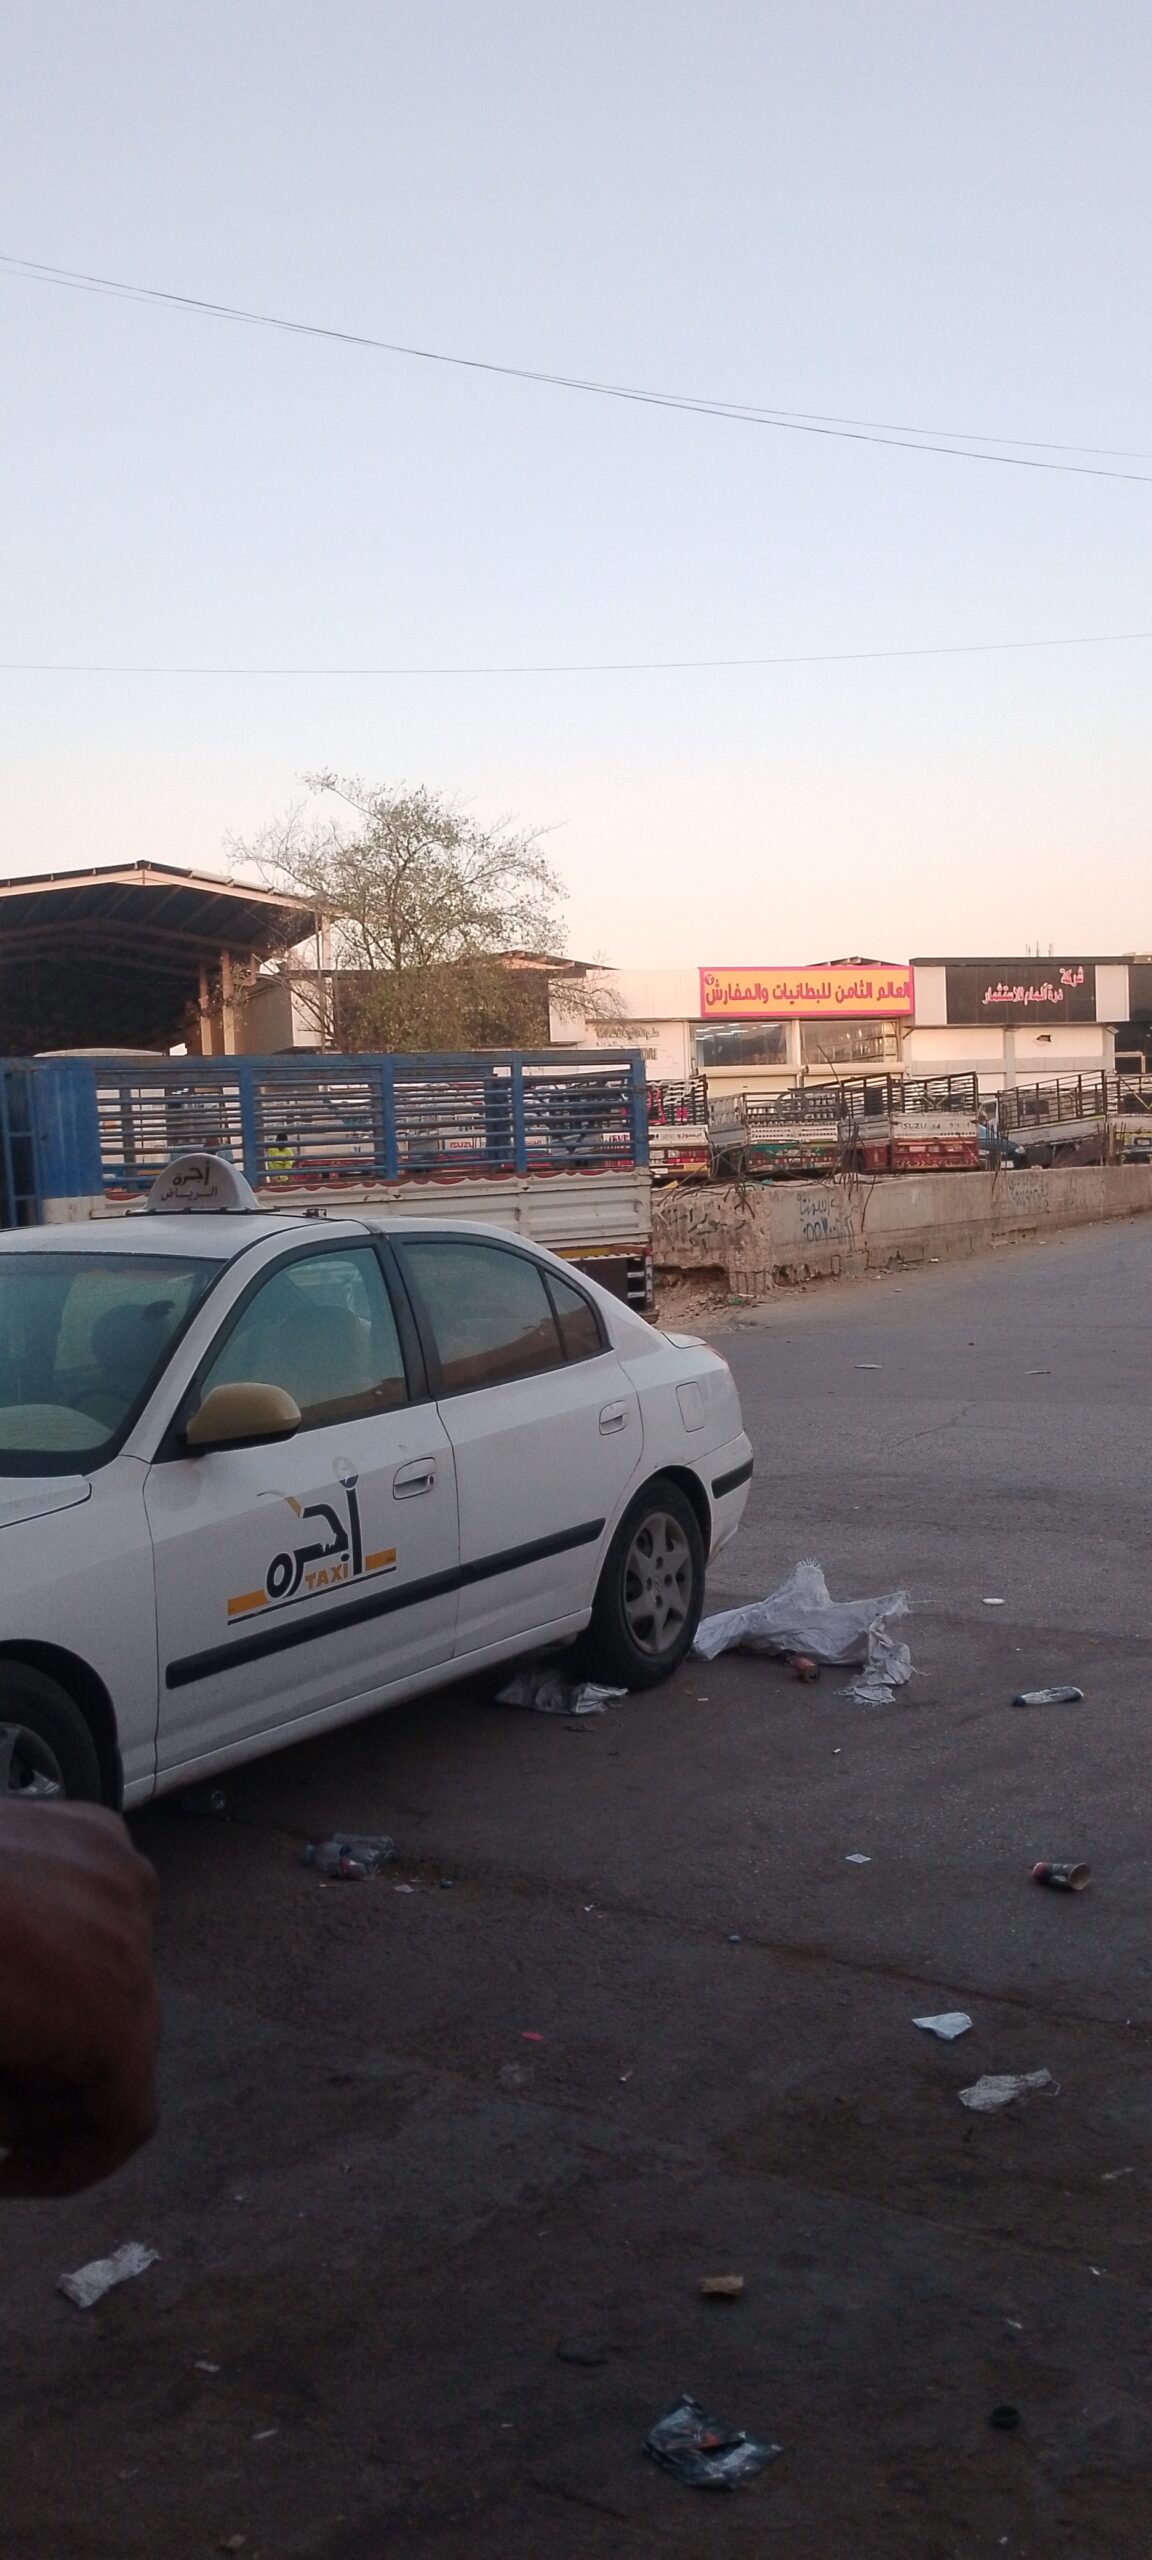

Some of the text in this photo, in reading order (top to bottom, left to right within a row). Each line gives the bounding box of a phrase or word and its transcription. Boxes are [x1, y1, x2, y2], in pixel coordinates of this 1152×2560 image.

[1059, 966, 1084, 987] شركة
[706, 979, 910, 1005] العالم الثامن للبطانيات والمفارش
[161, 1186, 218, 1201] الرياض
[305, 1563, 349, 1591] TAXI
